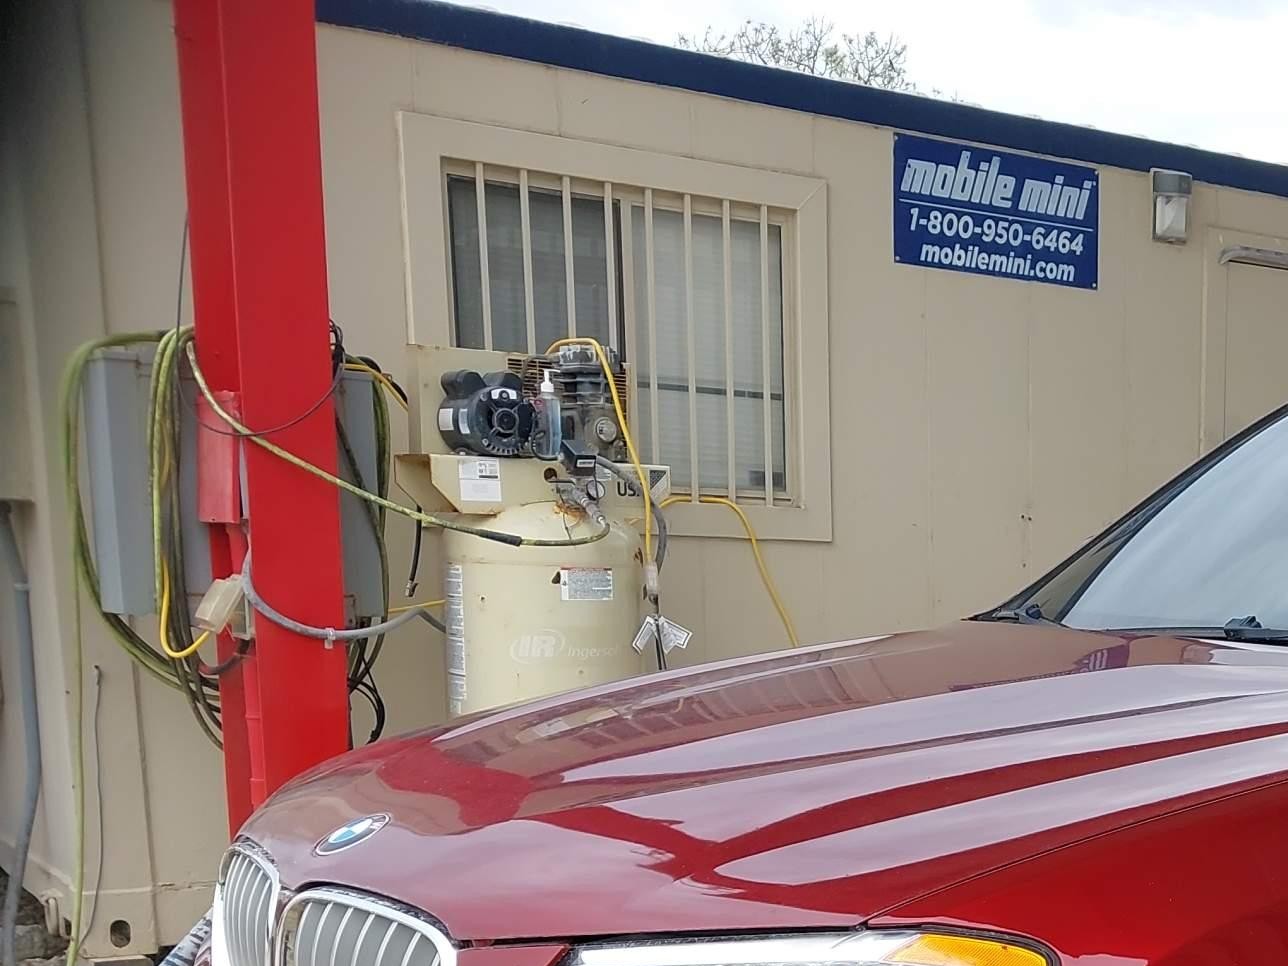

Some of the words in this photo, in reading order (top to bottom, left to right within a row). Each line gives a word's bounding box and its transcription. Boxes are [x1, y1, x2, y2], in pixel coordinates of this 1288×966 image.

[901, 150, 1016, 208] mobile
[1018, 175, 1092, 220] mini
[910, 207, 1084, 256] 1-800-950-6464
[920, 243, 1075, 282] mobilemini.com
[617, 481, 640, 497] US
